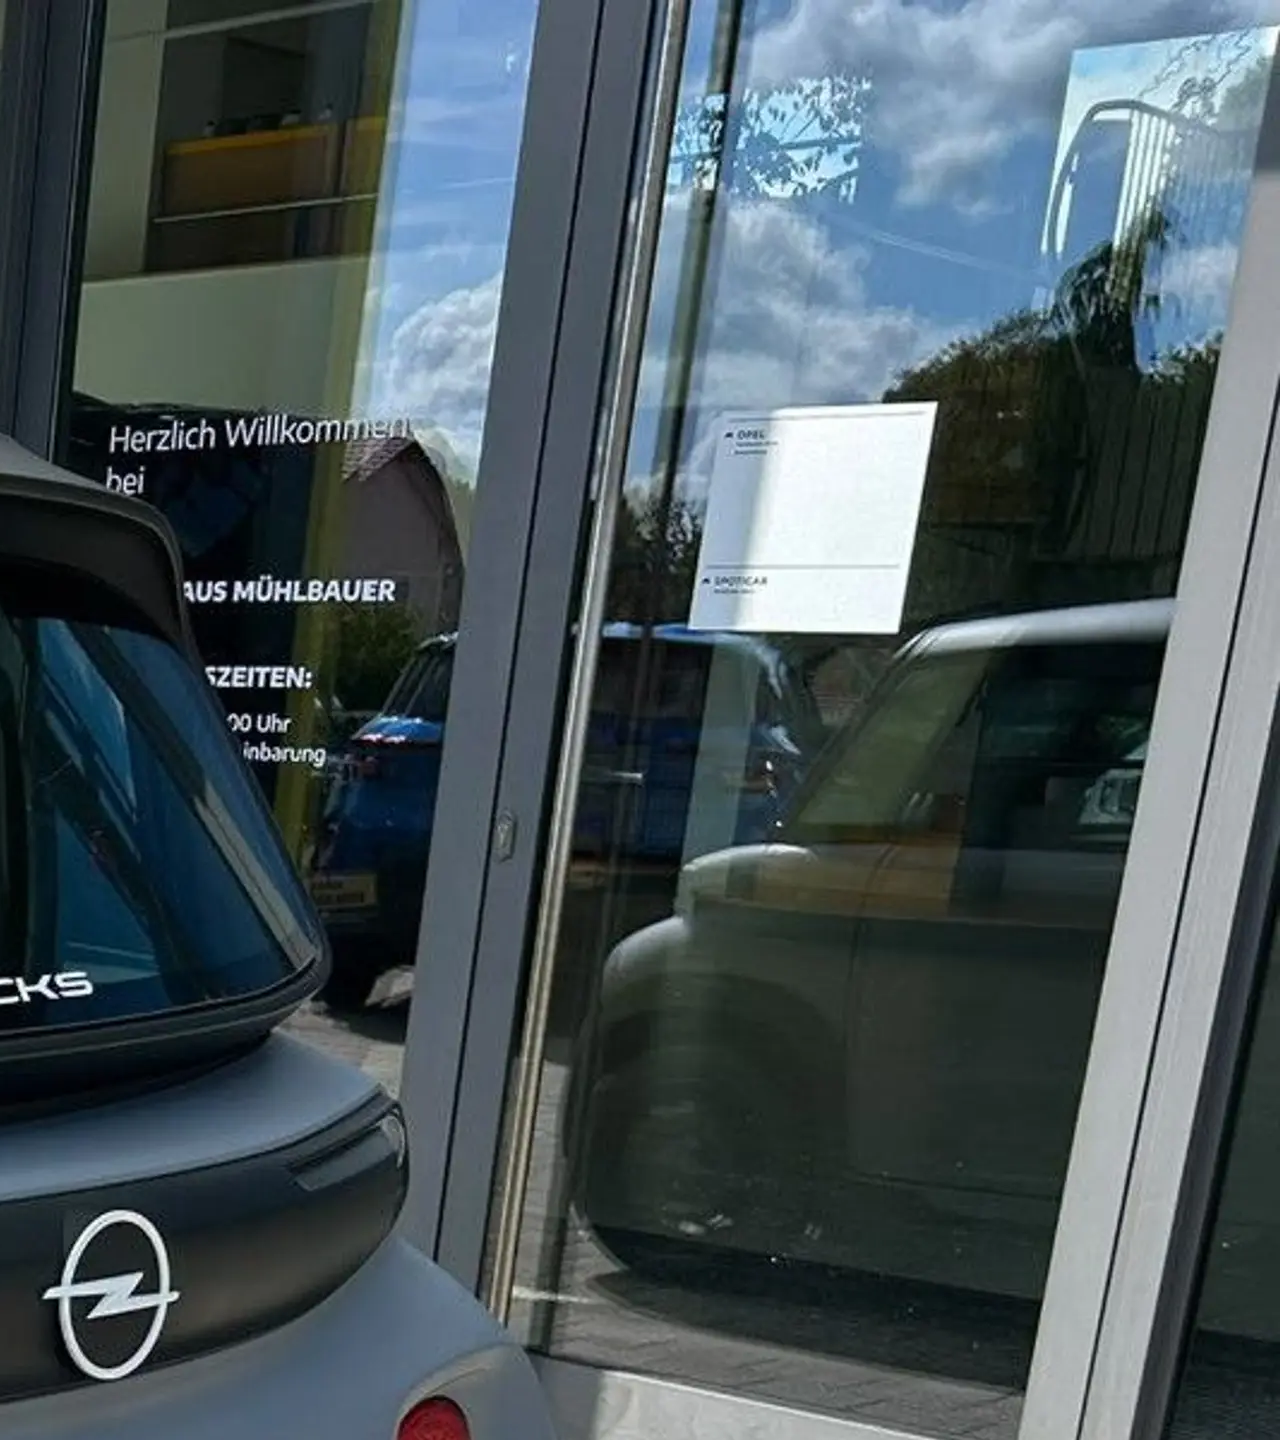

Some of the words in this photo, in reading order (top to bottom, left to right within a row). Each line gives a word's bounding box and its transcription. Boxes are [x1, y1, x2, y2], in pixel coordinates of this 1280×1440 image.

[109, 418, 216, 454] Herzlich
[224, 413, 408, 448] Willkommen
[106, 466, 146, 495] bei
[232, 574, 396, 603] MÜHLBAUER
[256, 713, 292, 733] Uhr
